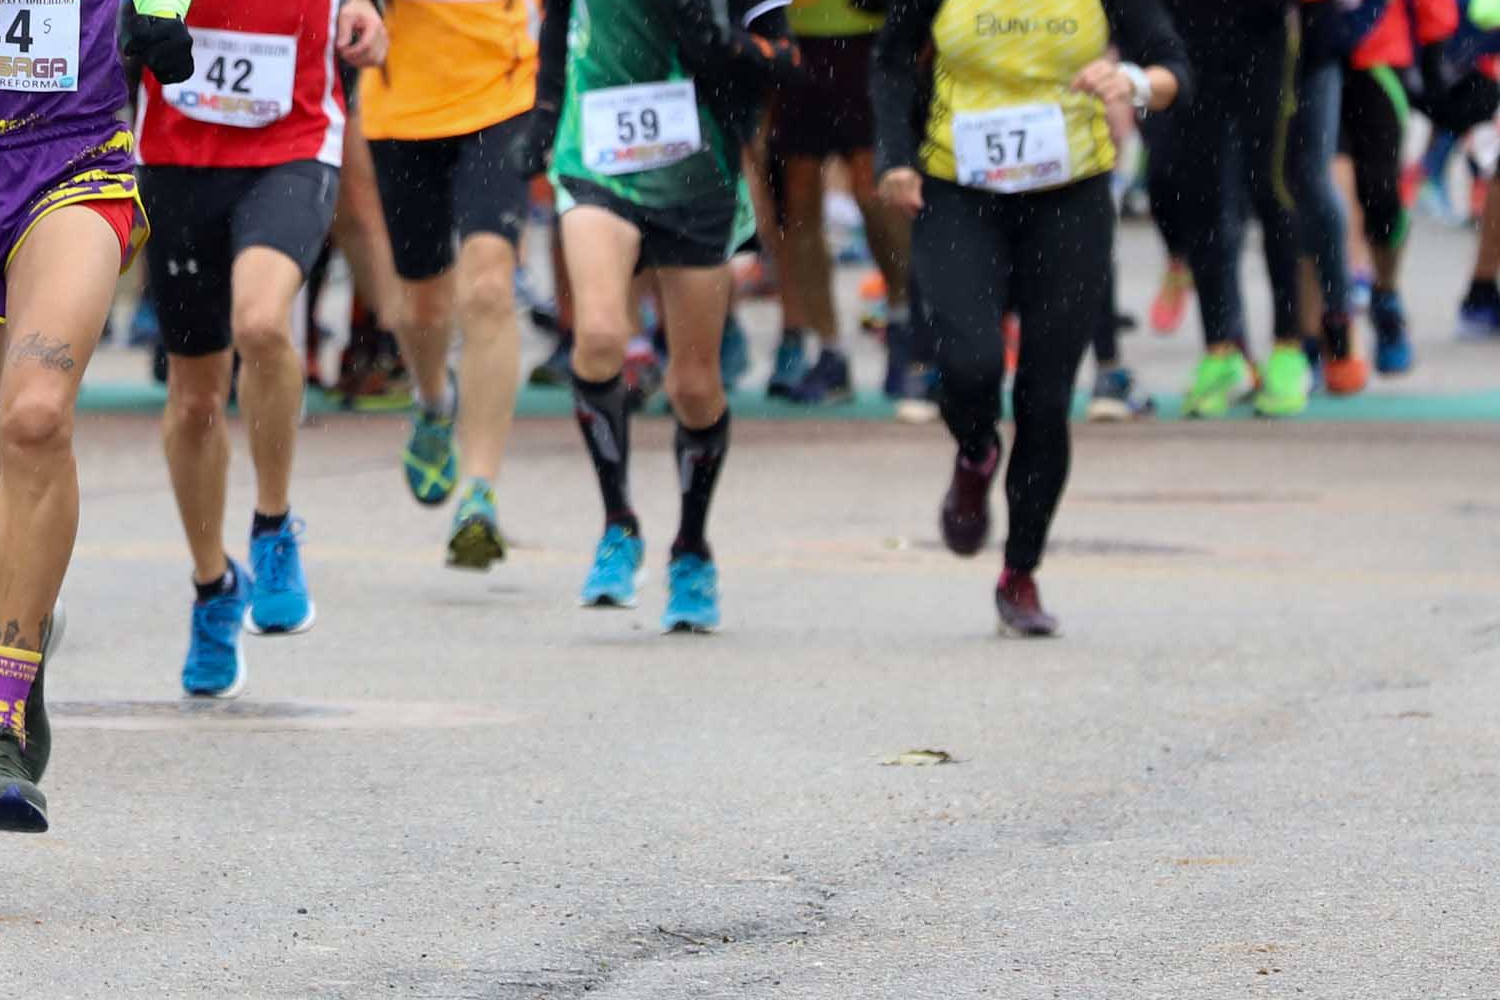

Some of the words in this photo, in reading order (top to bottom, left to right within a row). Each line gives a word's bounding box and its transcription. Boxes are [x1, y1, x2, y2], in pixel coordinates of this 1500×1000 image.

[206, 56, 253, 93] 42
[617, 108, 659, 142] 59
[986, 129, 1027, 165] 57
